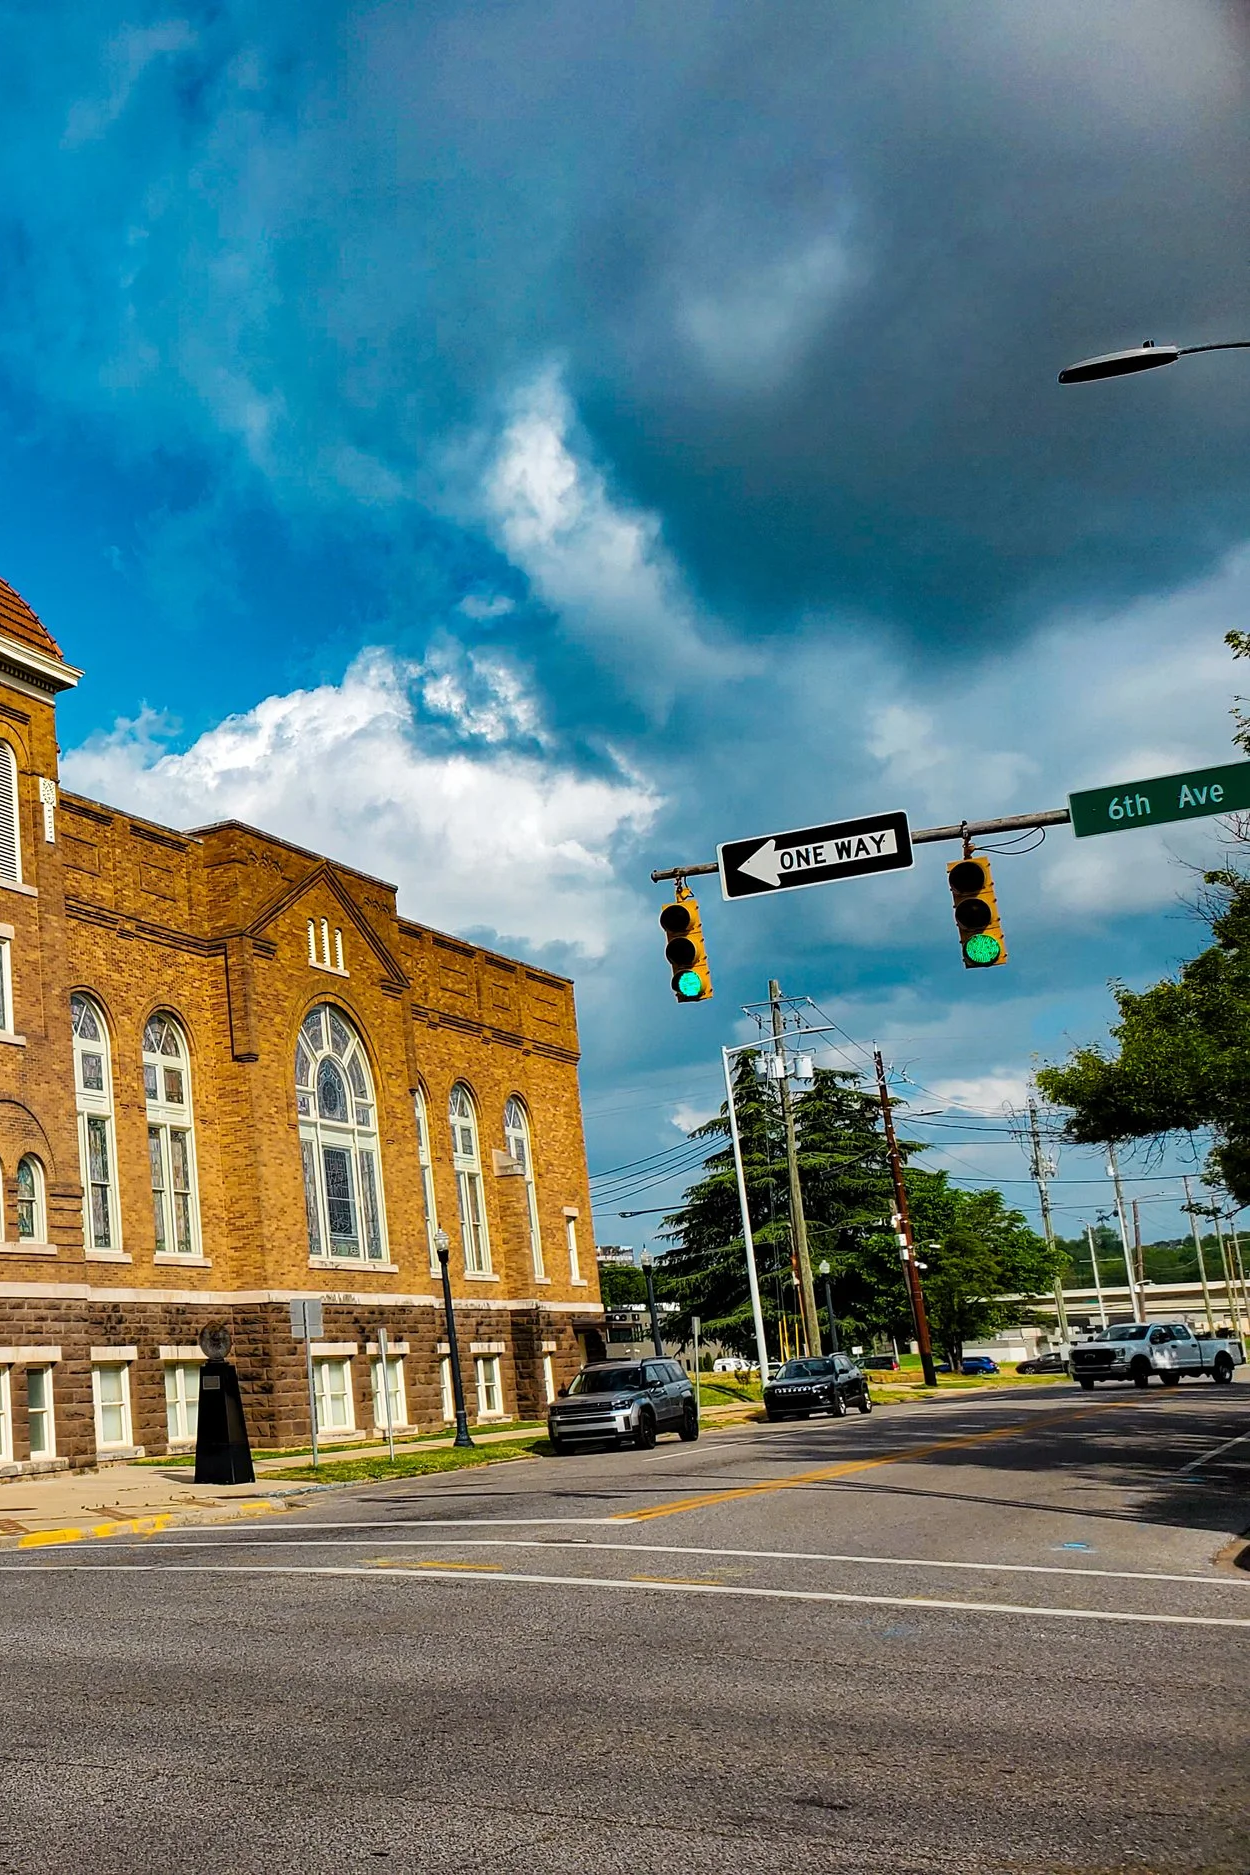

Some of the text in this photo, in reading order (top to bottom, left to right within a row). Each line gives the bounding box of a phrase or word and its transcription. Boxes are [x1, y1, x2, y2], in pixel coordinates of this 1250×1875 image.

[1108, 784, 1224, 820] 6th Ave
[779, 833, 886, 870] ONE WAY
